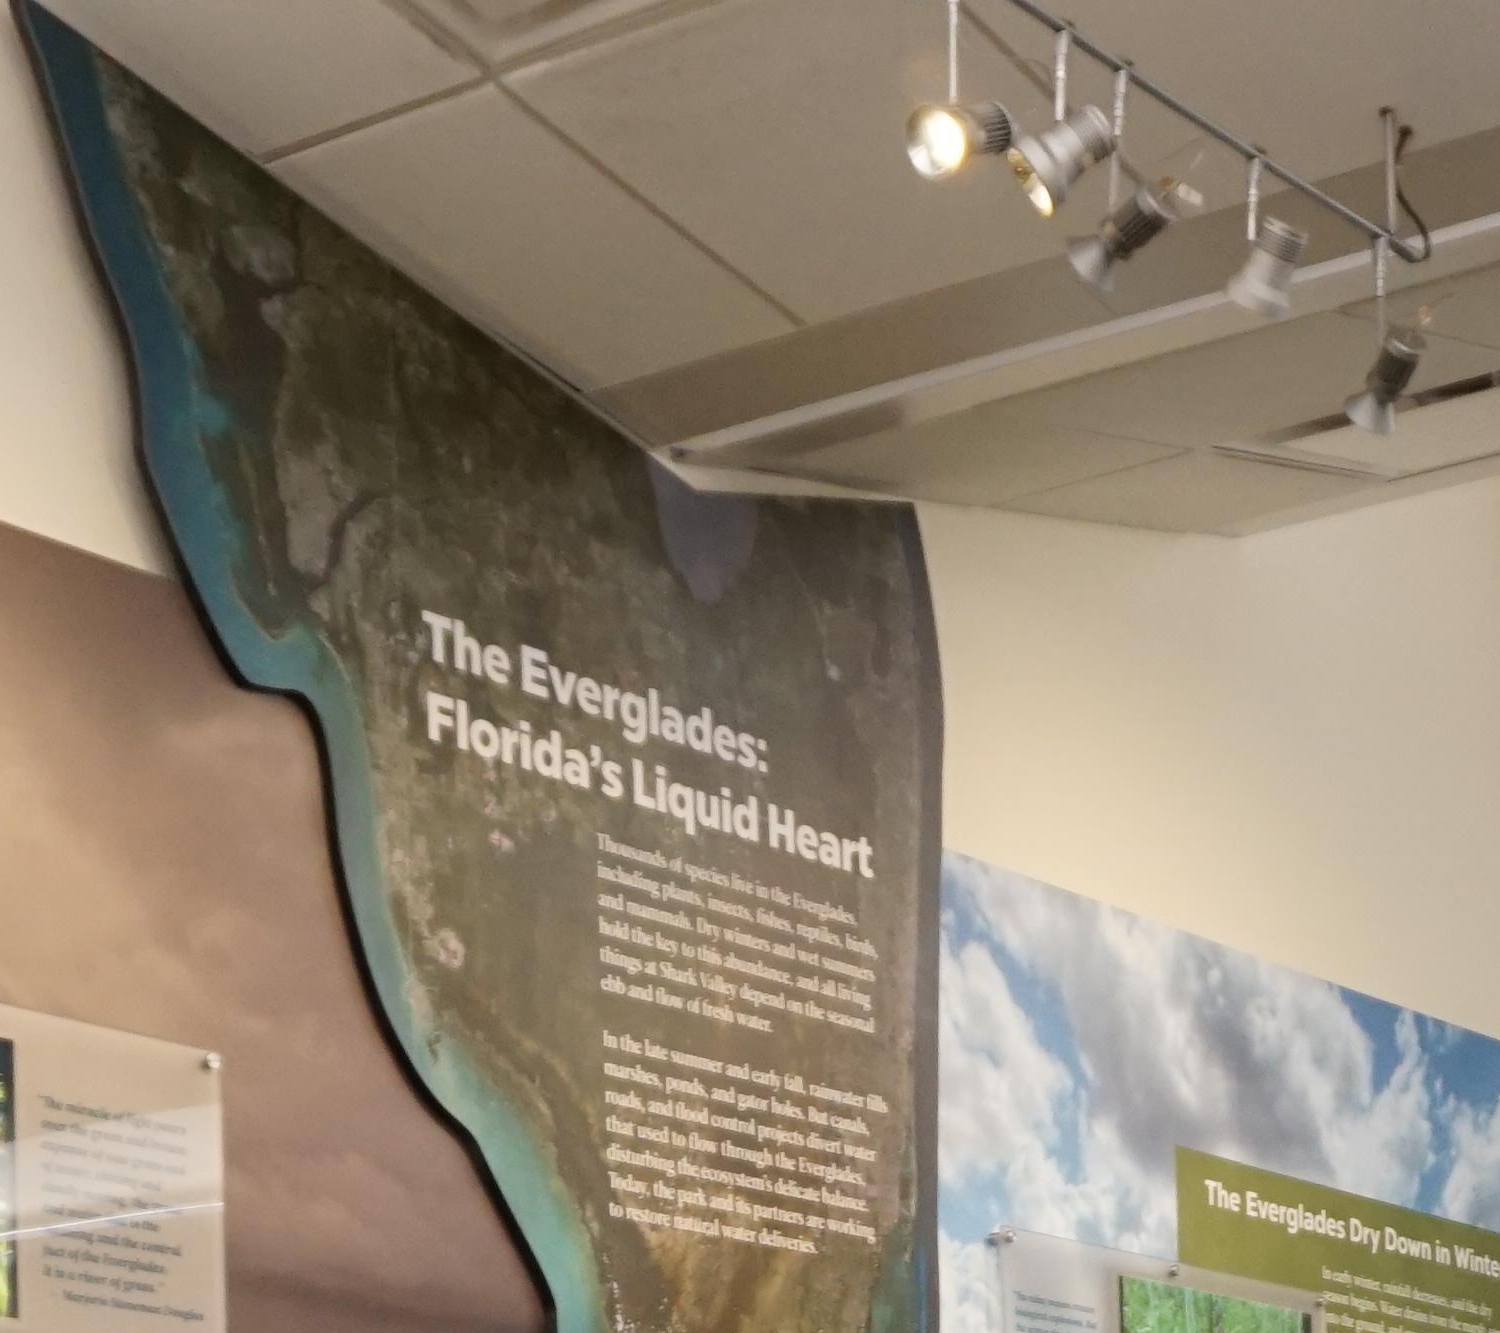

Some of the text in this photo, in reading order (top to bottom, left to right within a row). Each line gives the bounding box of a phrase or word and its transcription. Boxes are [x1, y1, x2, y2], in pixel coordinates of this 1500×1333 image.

[423, 609, 769, 773] The Everglades:
[426, 690, 875, 879] Florida's Liquid Heart
[1204, 1178, 1241, 1213] The
[1245, 1190, 1347, 1239] Everglades
[1349, 1217, 1381, 1254] Dry
[1384, 1226, 1432, 1261] Down
[1435, 1239, 1451, 1266] in
